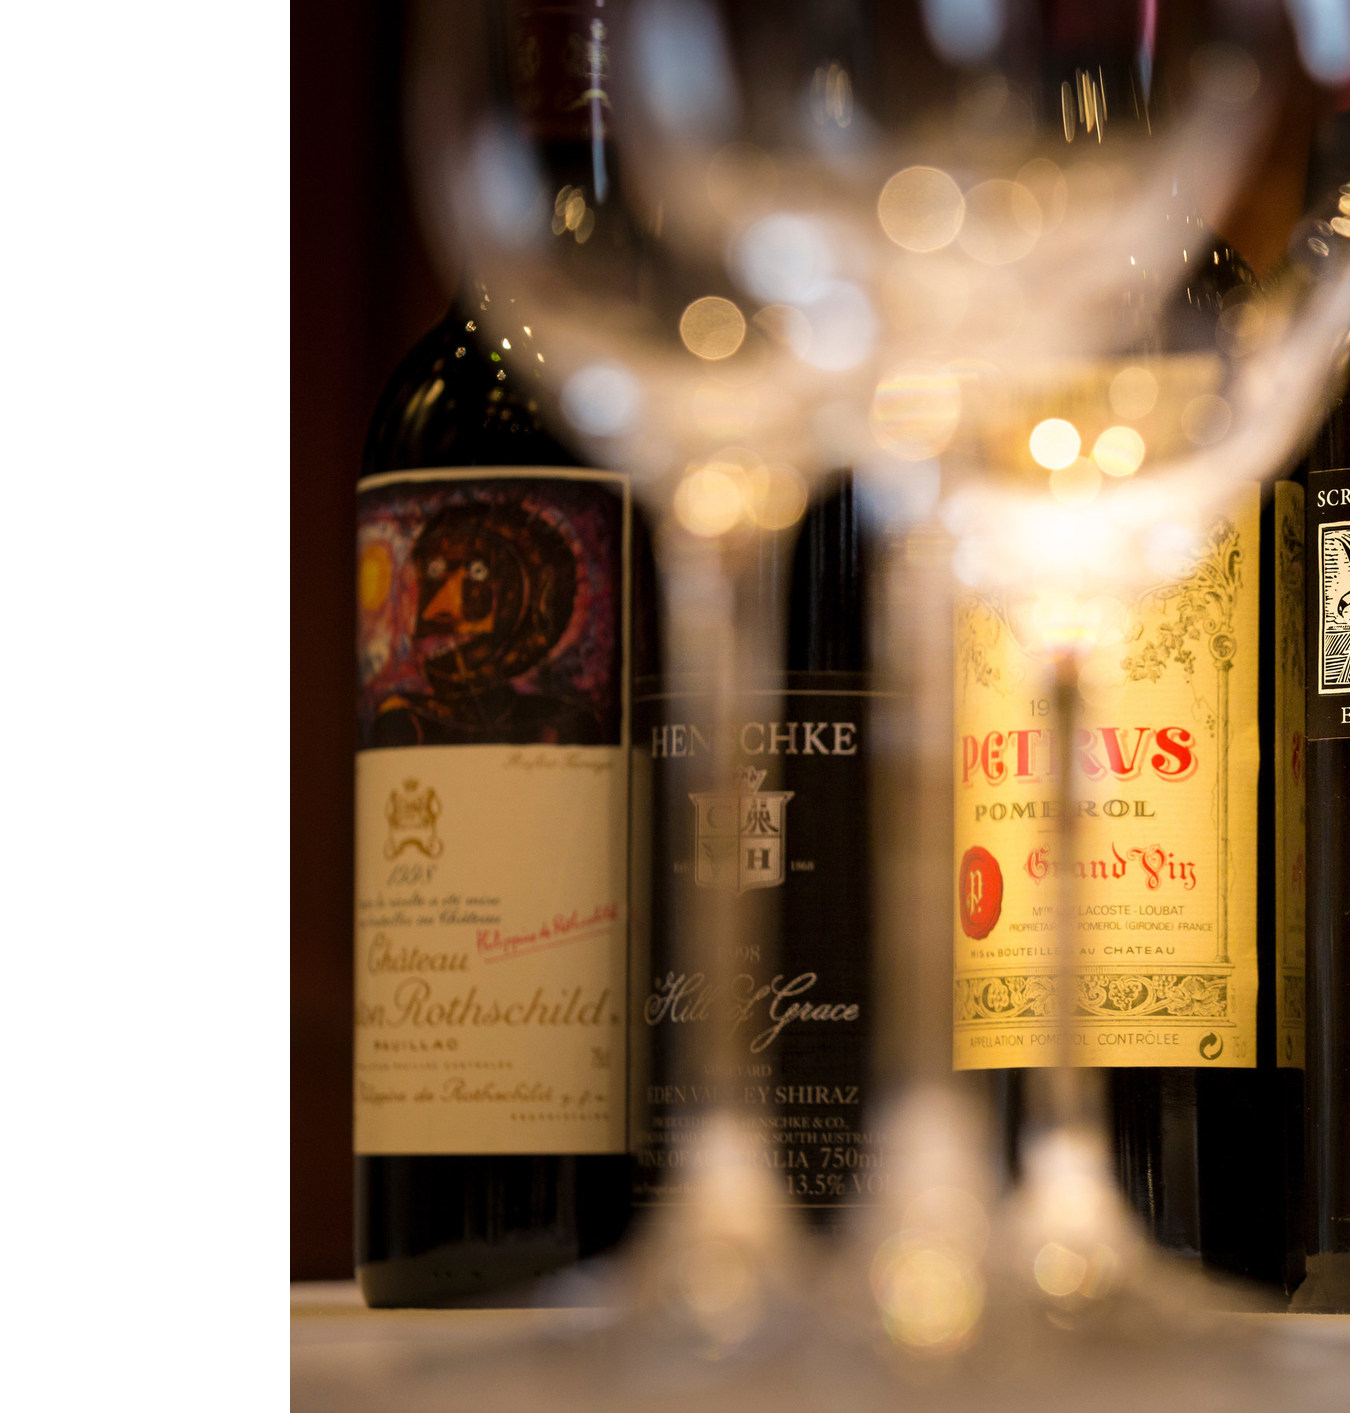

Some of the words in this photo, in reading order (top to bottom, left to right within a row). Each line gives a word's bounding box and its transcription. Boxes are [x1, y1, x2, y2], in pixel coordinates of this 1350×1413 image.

[652, 721, 858, 758] HENCHKE
[974, 799, 1156, 822] POMEROL
[1077, 920, 1121, 932] POMEROL
[1178, 921, 1214, 933] FRANCE
[367, 930, 470, 977] Château
[997, 946, 1068, 958] BOUTEILLE
[1079, 946, 1097, 956] AU
[1103, 945, 1176, 957] CHATEAU
[388, 975, 612, 1028] Rothschild
[644, 970, 716, 1027] Hill
[750, 971, 861, 1054] Grace
[1030, 1033, 1090, 1047] POMOL
[647, 1085, 687, 1105] EDEN
[774, 1084, 861, 1105] SHIRAZ
[812, 1116, 824, 1129] &
[772, 1131, 819, 1145] SOUTH
[693, 1149, 809, 1168] AURALIA
[787, 1174, 845, 1196] 13.5%
